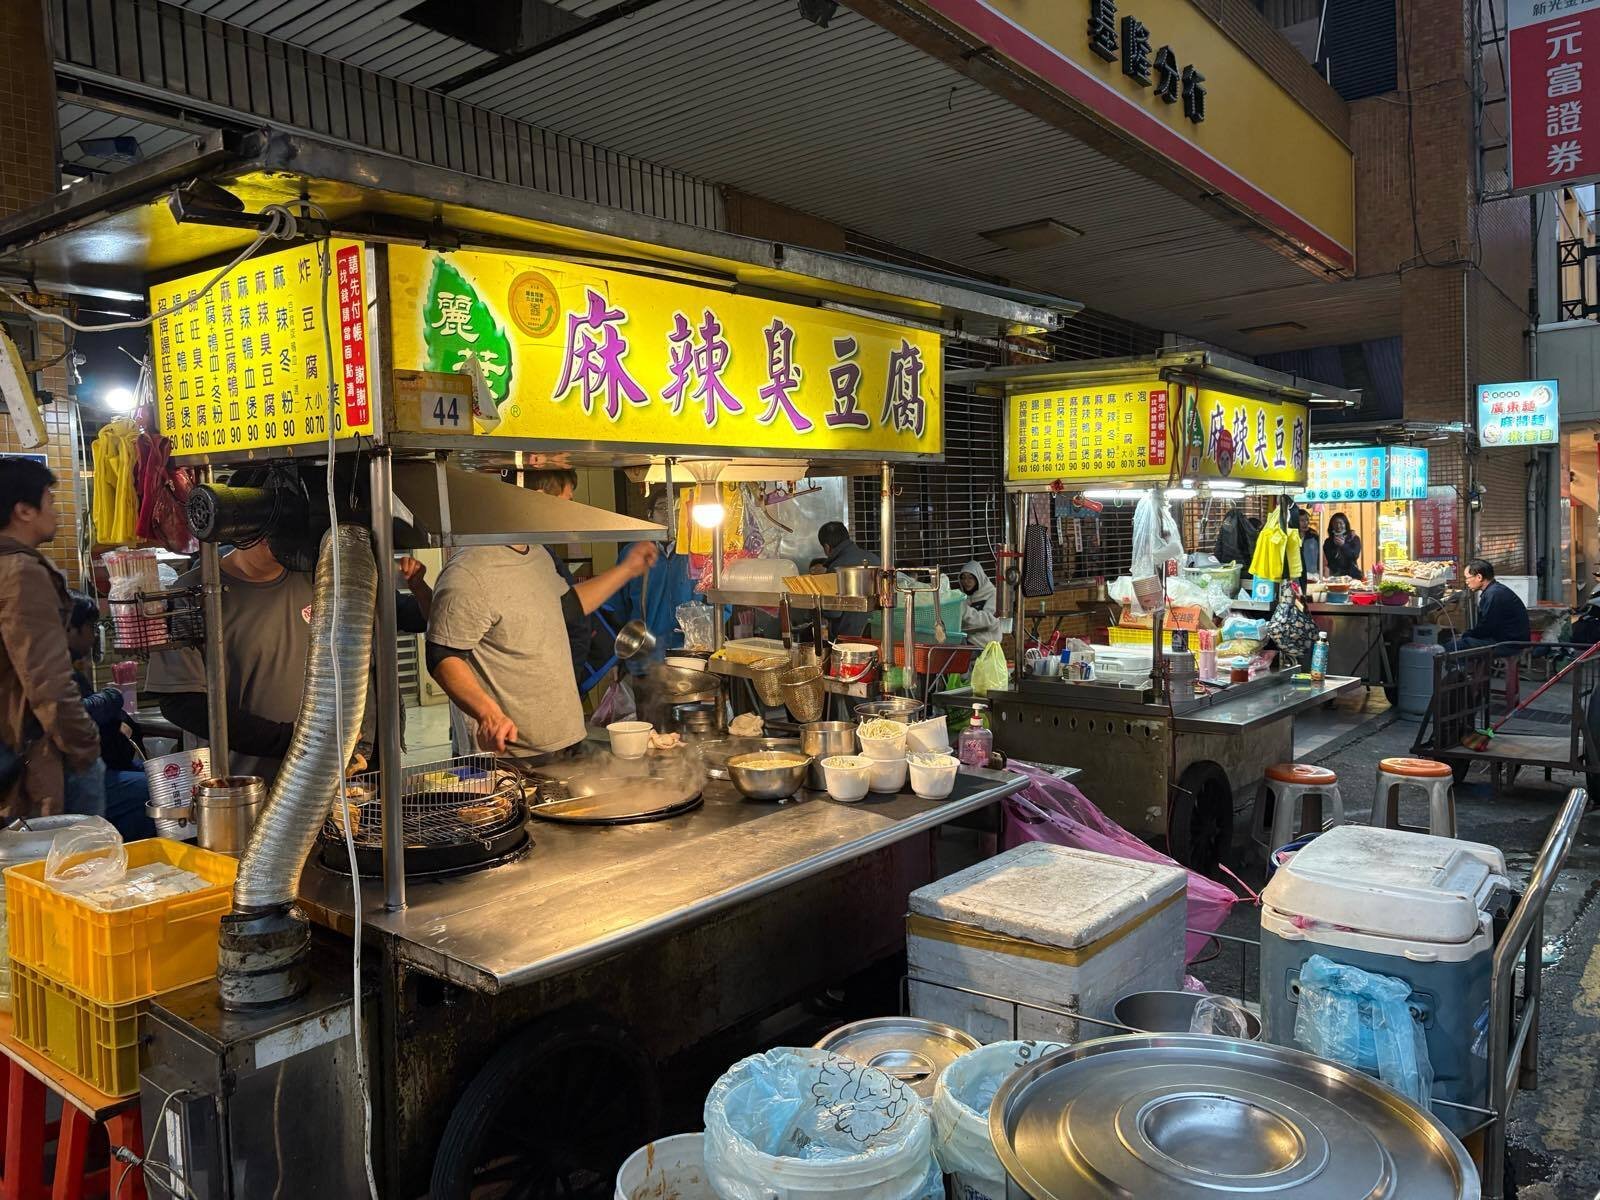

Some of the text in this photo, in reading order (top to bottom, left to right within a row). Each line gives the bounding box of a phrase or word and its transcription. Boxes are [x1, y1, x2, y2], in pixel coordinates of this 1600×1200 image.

[1532, 0, 1596, 16] 新光金
[1545, 20, 1584, 175] 元富證券
[297, 257, 318, 380] 炸豆腐
[219, 280, 241, 443] 麻辣豆腐鴨血 90
[237, 275, 259, 441] 麻辣鴨血煲 90
[254, 270, 277, 439] 麻辣臭豆腐 90
[272, 265, 295, 437] 麻辣冬粉 90
[554, 288, 927, 439] 麻辣臭豆腐
[304, 392, 314, 434] 大 80
[314, 391, 325, 433] 小 70
[433, 396, 459, 426] 44
[1123, 392, 1133, 444] 炸豆腐
[181, 433, 194, 449] 160
[196, 430, 209, 447] 160
[212, 428, 226, 445] 120
[1106, 393, 1117, 469] 麻辣冬粉 90
[1137, 391, 1147, 468] 泡菜 50
[1207, 401, 1304, 471] 麻辣臭豆腐
[169, 434, 179, 450] 60
[1017, 464, 1027, 473] 160
[1029, 464, 1040, 472] 160
[1042, 463, 1052, 472] 160
[1054, 462, 1065, 471] 120
[1068, 462, 1078, 471] 90
[1081, 461, 1090, 470] 90
[1094, 461, 1103, 469] 90
[1120, 450, 1128, 468] 大 80
[1128, 449, 1135, 468] 小 70
